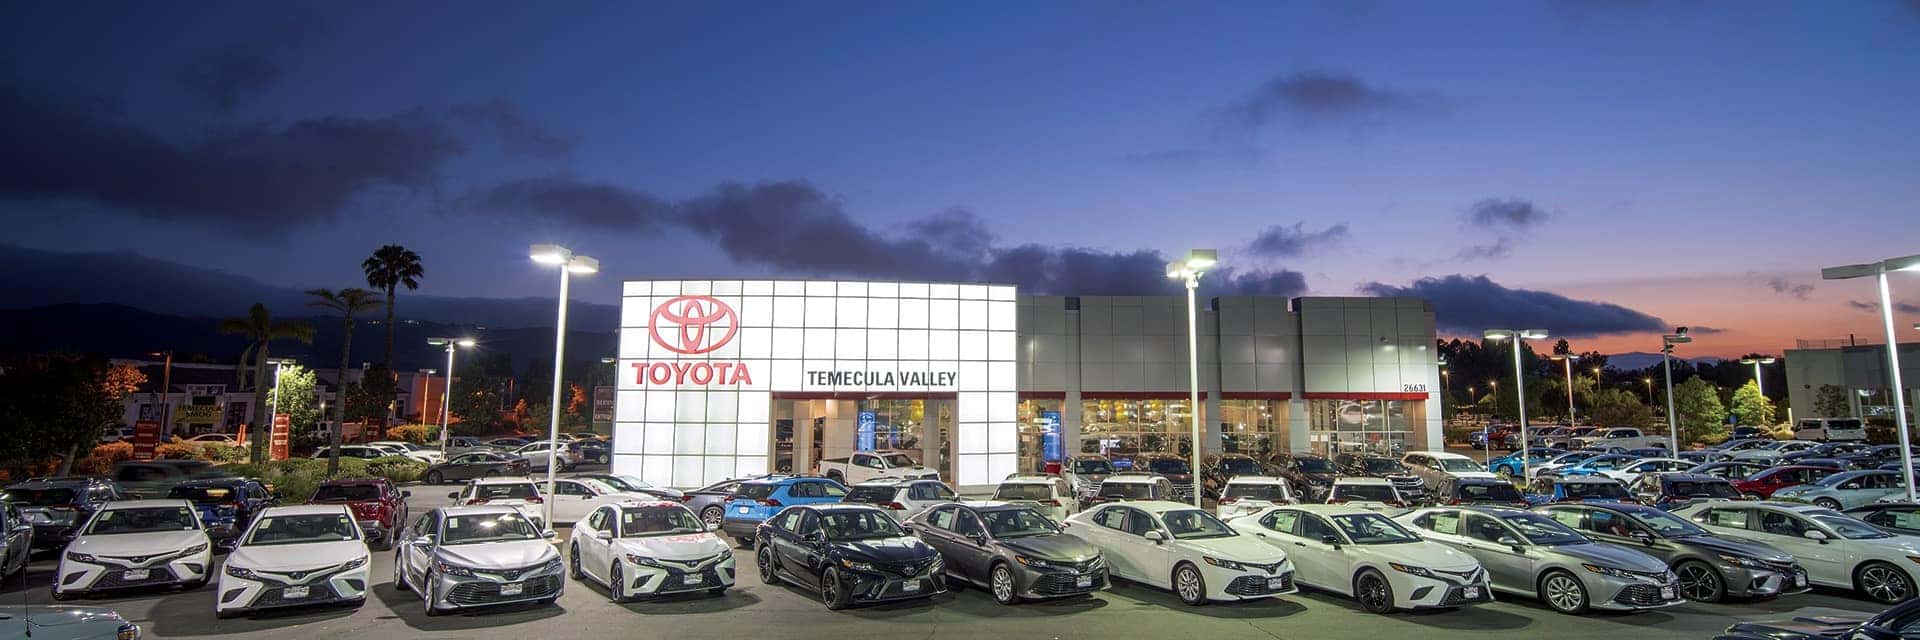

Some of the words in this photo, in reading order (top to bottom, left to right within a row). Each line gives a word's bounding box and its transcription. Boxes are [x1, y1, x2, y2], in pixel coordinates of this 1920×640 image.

[632, 362, 752, 386] TOYOTA
[808, 371, 895, 387] TEMECULA
[900, 371, 957, 387] VALLEY
[1404, 384, 1426, 392] 26631
